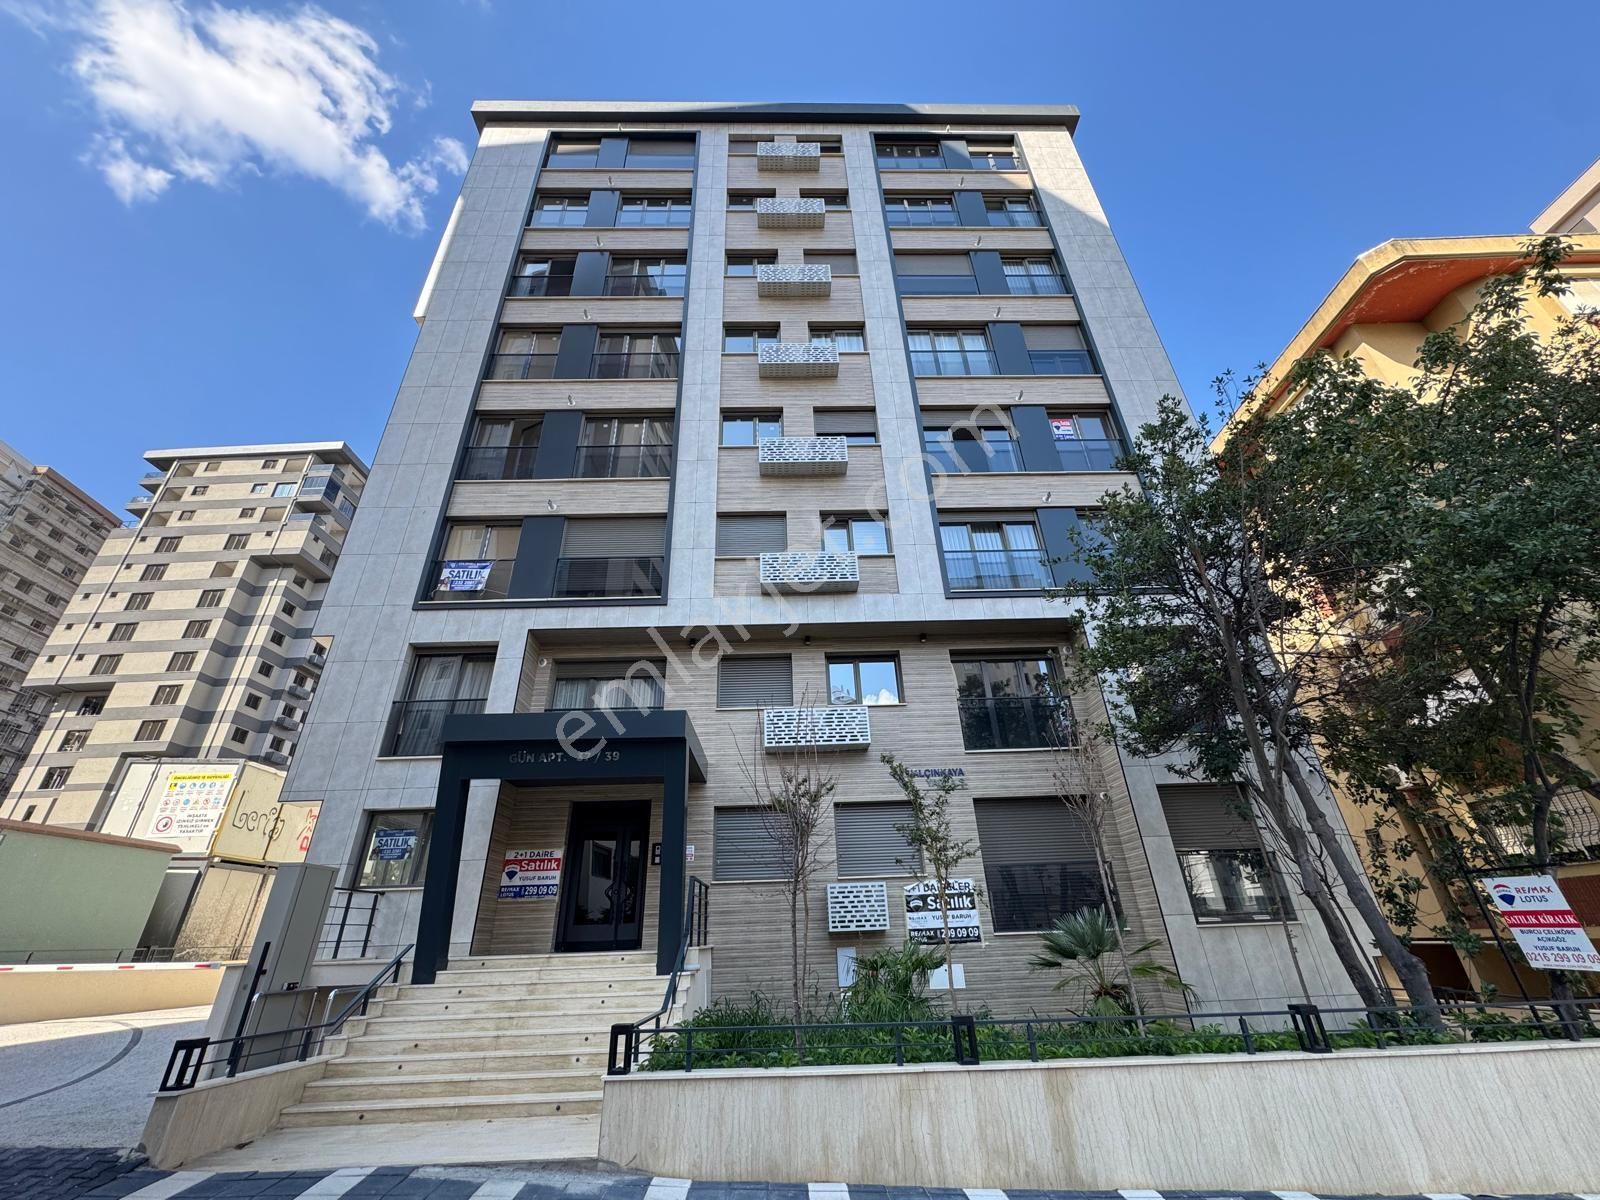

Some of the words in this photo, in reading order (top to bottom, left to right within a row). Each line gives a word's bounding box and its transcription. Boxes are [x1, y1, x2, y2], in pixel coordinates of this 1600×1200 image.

[509, 751, 535, 763] GÜN
[604, 751, 620, 761] 39
[514, 851, 528, 859] 2+1
[529, 850, 555, 859] DAİRE
[521, 860, 559, 871] Satılık
[524, 886, 538, 895] 299
[538, 886, 548, 895] 09
[548, 885, 558, 895] 09
[1514, 885, 1553, 894] RE/MAX
[1519, 895, 1549, 903] LOTUS
[1504, 915, 1537, 925] SATILIK
[1539, 913, 1579, 925] KİRALIK
[956, 928, 967, 938] 09
[968, 927, 979, 937] 09
[1526, 952, 1550, 962] 0216
[1550, 953, 1571, 963] 299
[1572, 953, 1586, 963] 09
[1587, 954, 1600, 964] 09
